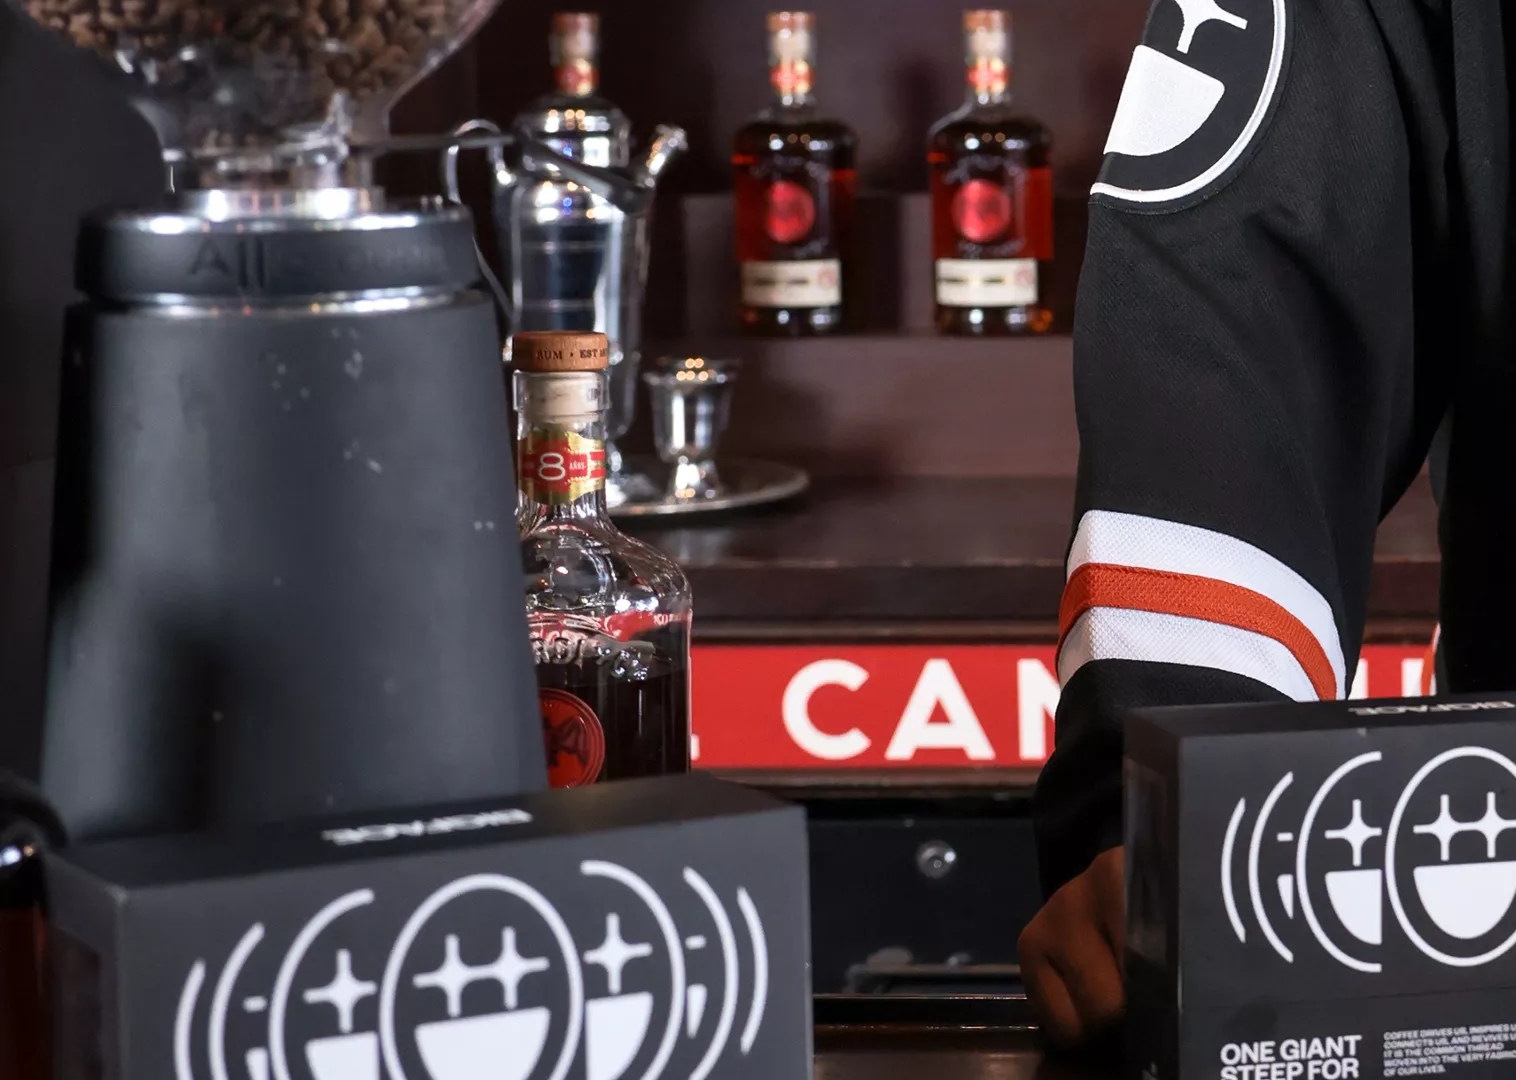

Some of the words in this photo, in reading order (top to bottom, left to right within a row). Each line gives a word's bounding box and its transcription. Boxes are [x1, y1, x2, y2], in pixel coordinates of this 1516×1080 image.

[538, 452, 566, 481] 8
[1383, 1030, 1419, 1040] COFFEE
[1420, 1027, 1453, 1038] DRIVES
[1469, 1023, 1509, 1034] INSPIRES
[1220, 1041, 1276, 1066] ONE
[1279, 1034, 1363, 1062] GIANT
[1383, 1038, 1434, 1050] CONNECTS
[1450, 1035, 1470, 1045] AND
[1404, 1047, 1422, 1057] THE
[1423, 1044, 1466, 1056] COMMON
[1467, 1041, 1504, 1052] THREAD
[1220, 1061, 1304, 1080] STEEP
[1307, 1057, 1360, 1080] FOR
